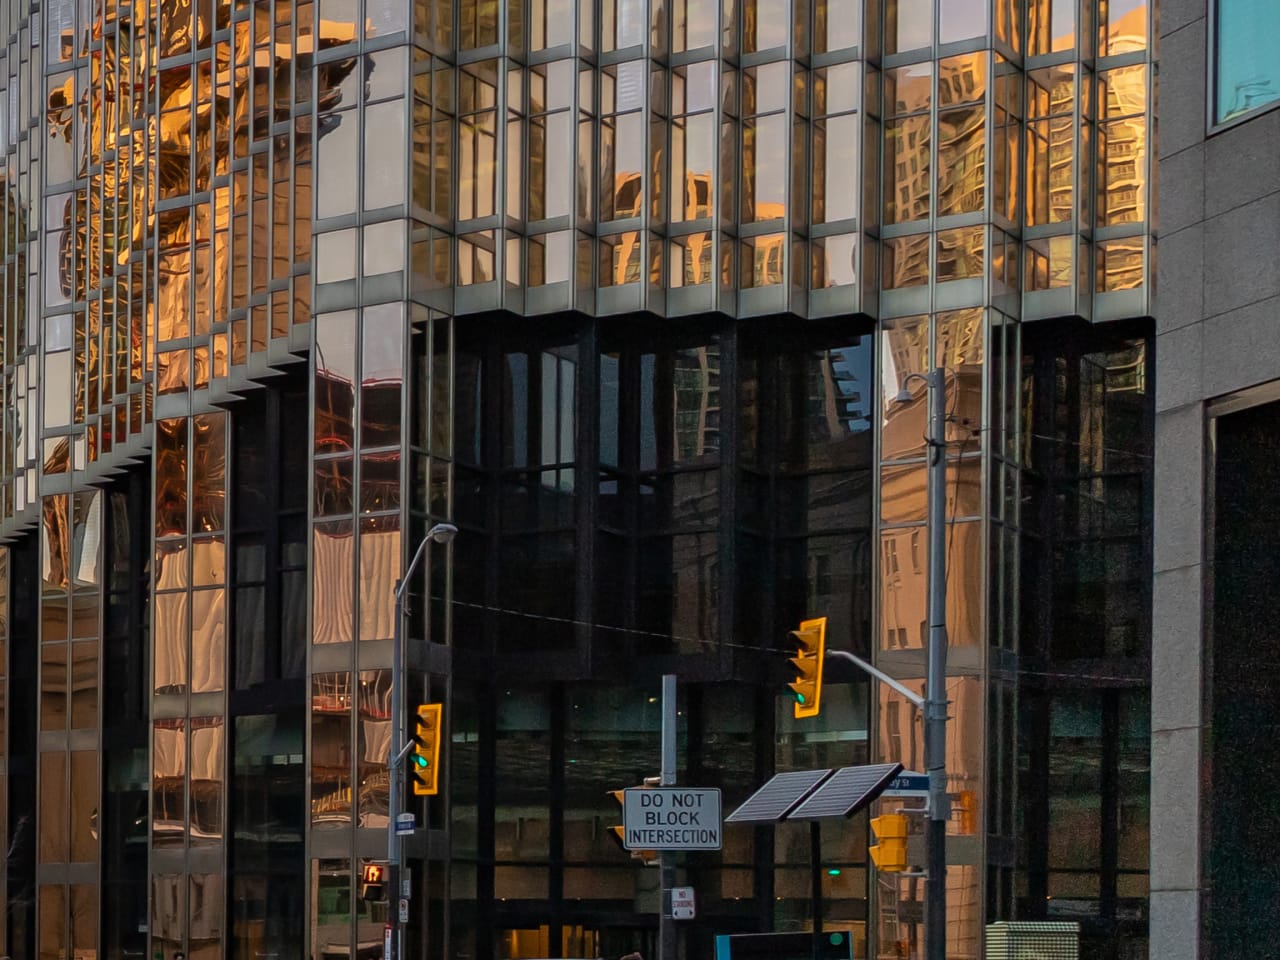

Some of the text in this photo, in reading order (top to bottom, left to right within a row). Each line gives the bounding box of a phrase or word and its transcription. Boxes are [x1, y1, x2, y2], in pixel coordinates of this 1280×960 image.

[640, 793, 704, 808] DO NOT
[645, 811, 701, 826] BLOCK
[628, 829, 718, 844] INTERSECTION
